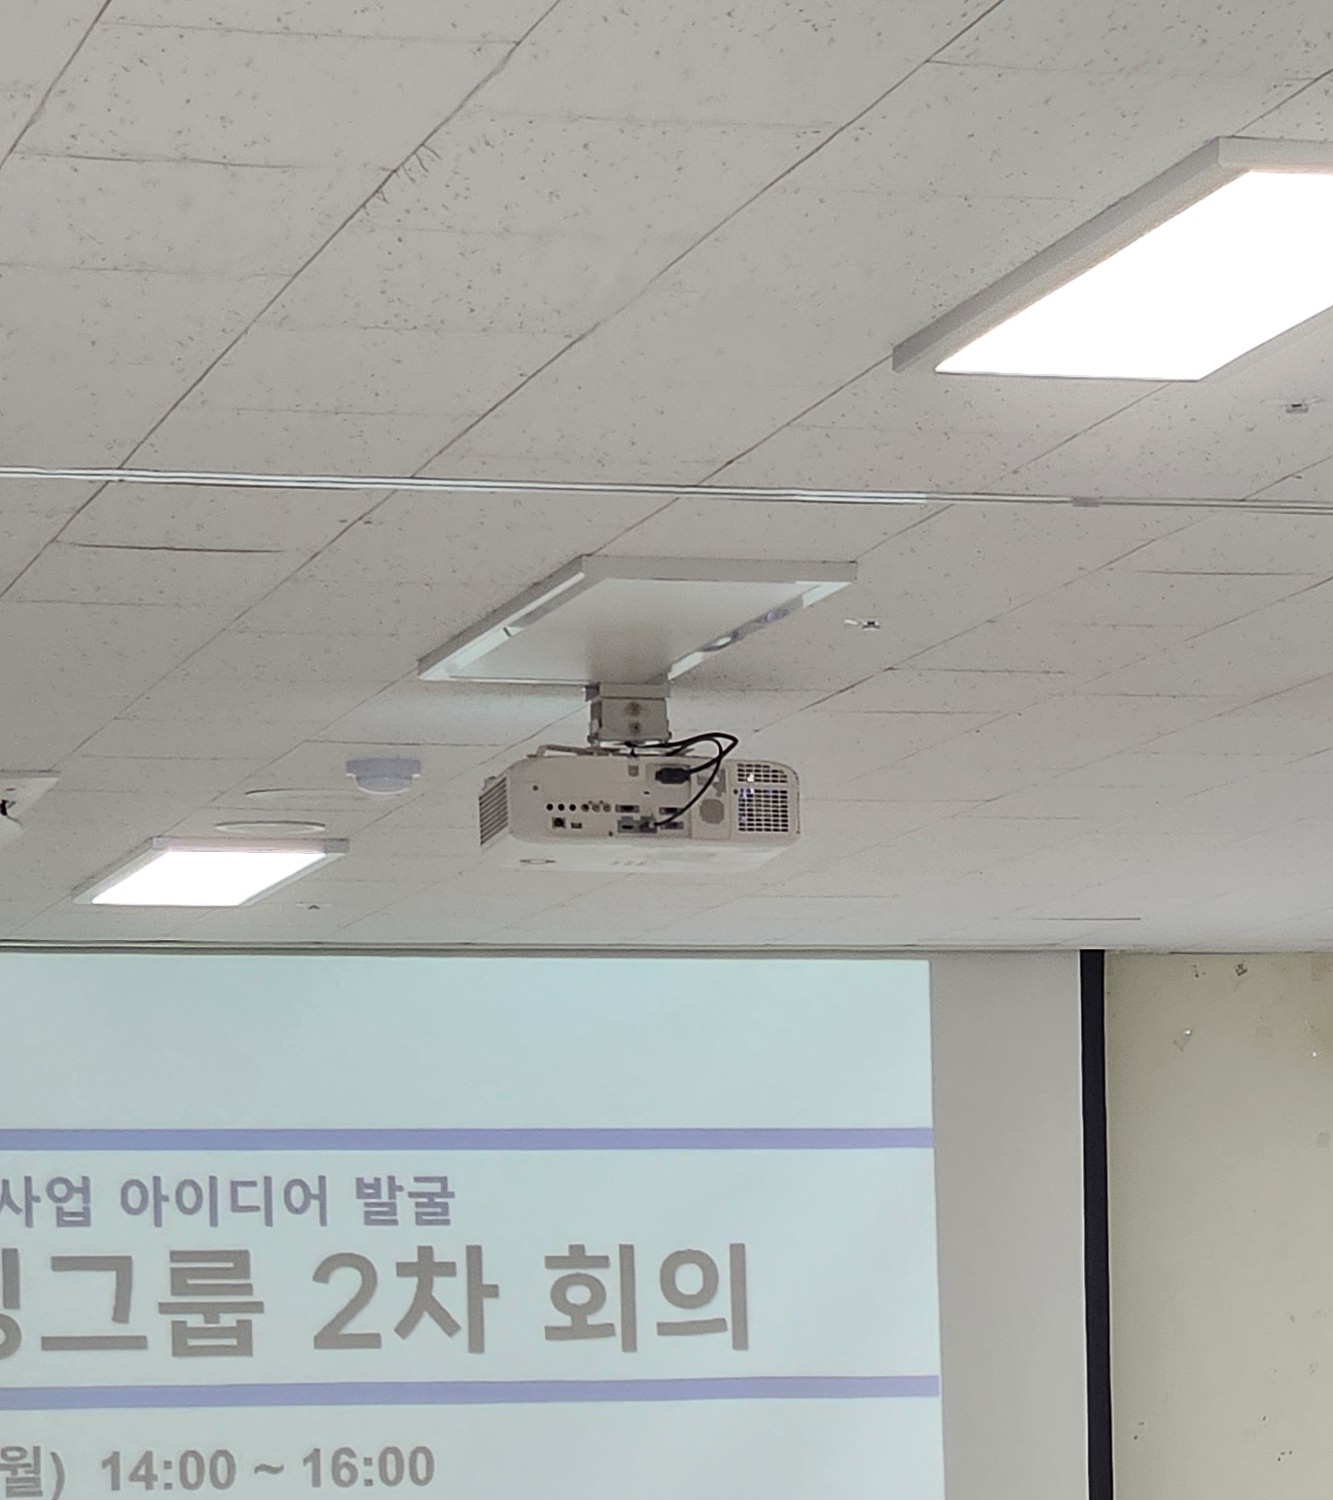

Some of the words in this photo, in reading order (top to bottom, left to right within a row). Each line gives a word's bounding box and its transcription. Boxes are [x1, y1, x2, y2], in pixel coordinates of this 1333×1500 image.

[0, 1175, 91, 1228] 사업
[121, 1174, 327, 1228] 아이디어
[355, 1174, 456, 1227] 발굴
[311, 1244, 501, 1355] 2차
[543, 1242, 750, 1354] 회의
[101, 1448, 237, 1492] 14:00
[302, 1445, 435, 1488] 16:00
